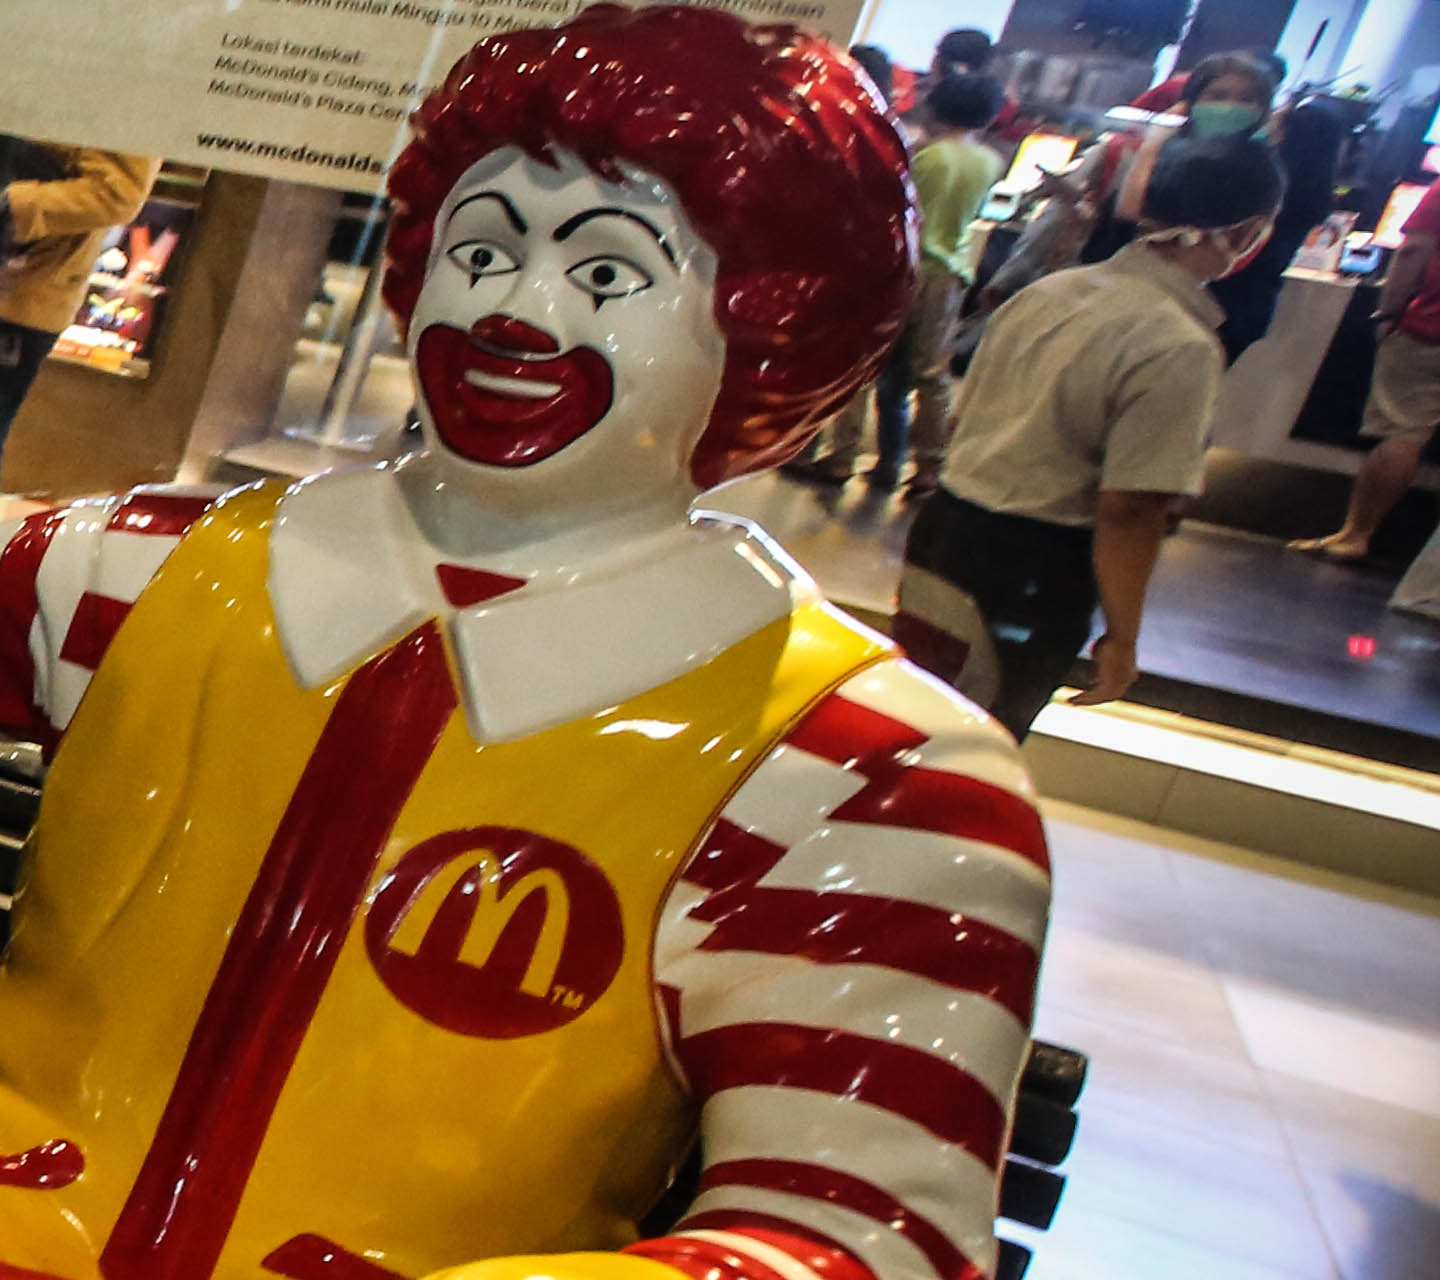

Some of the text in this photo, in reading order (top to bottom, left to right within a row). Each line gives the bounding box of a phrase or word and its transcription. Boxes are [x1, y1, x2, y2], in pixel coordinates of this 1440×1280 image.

[221, 32, 281, 55] Lokasi
[214, 55, 320, 83] McDonald's
[206, 79, 314, 109] McDonald's
[316, 94, 366, 117] Plaza
